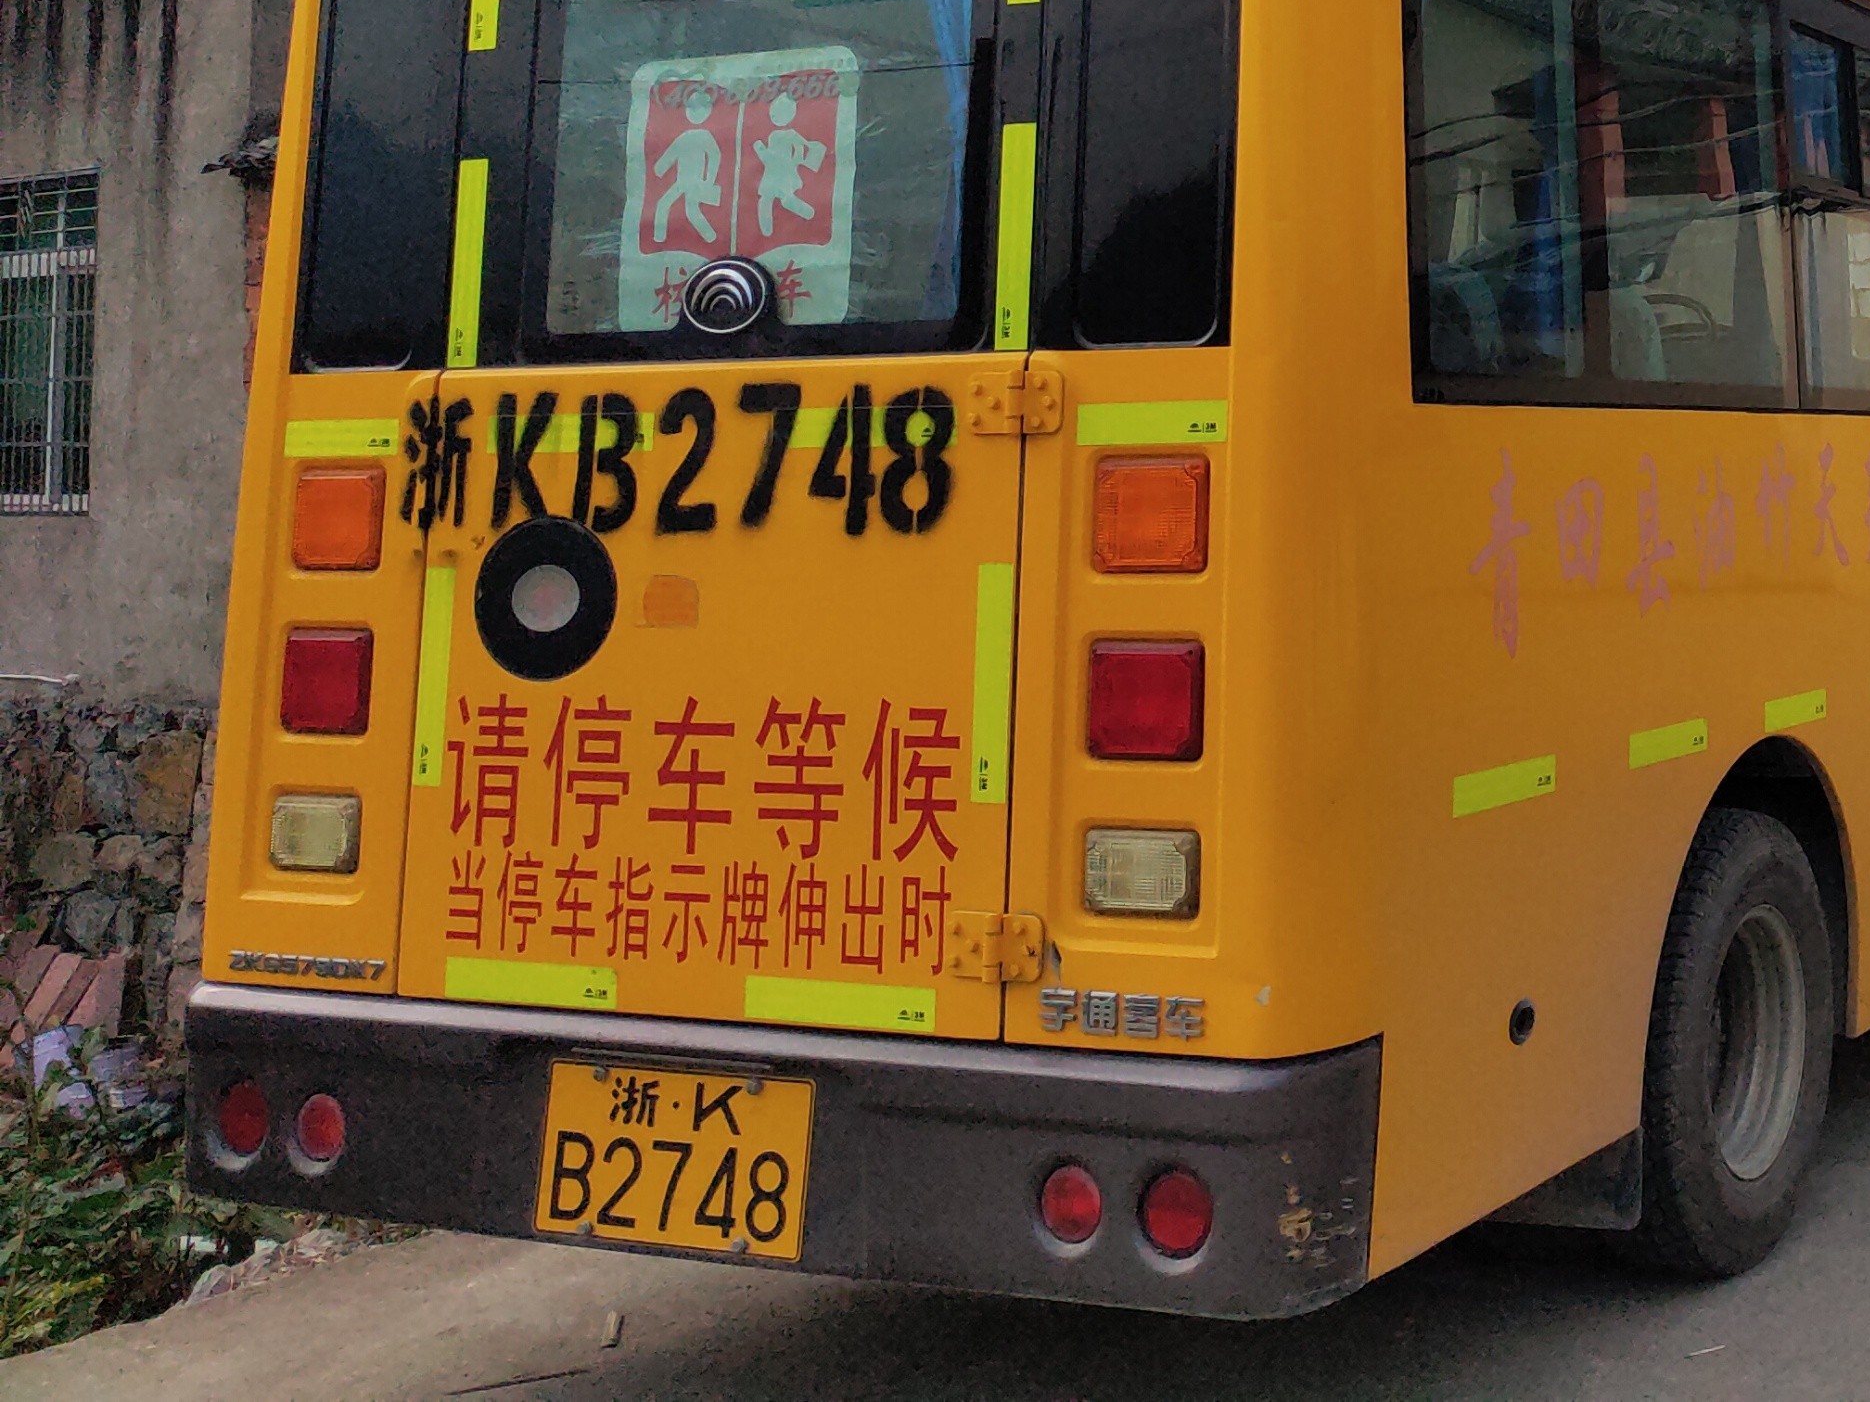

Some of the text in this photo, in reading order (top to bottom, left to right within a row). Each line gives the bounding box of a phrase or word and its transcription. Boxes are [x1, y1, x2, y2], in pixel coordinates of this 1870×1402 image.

[400, 381, 955, 536] 浙KB2748
[447, 694, 961, 862] 请停车等候
[446, 849, 952, 977] 当停车指示牌伸出时
[1040, 987, 1206, 1043] 宇通客车
[549, 1130, 790, 1243] B2748
